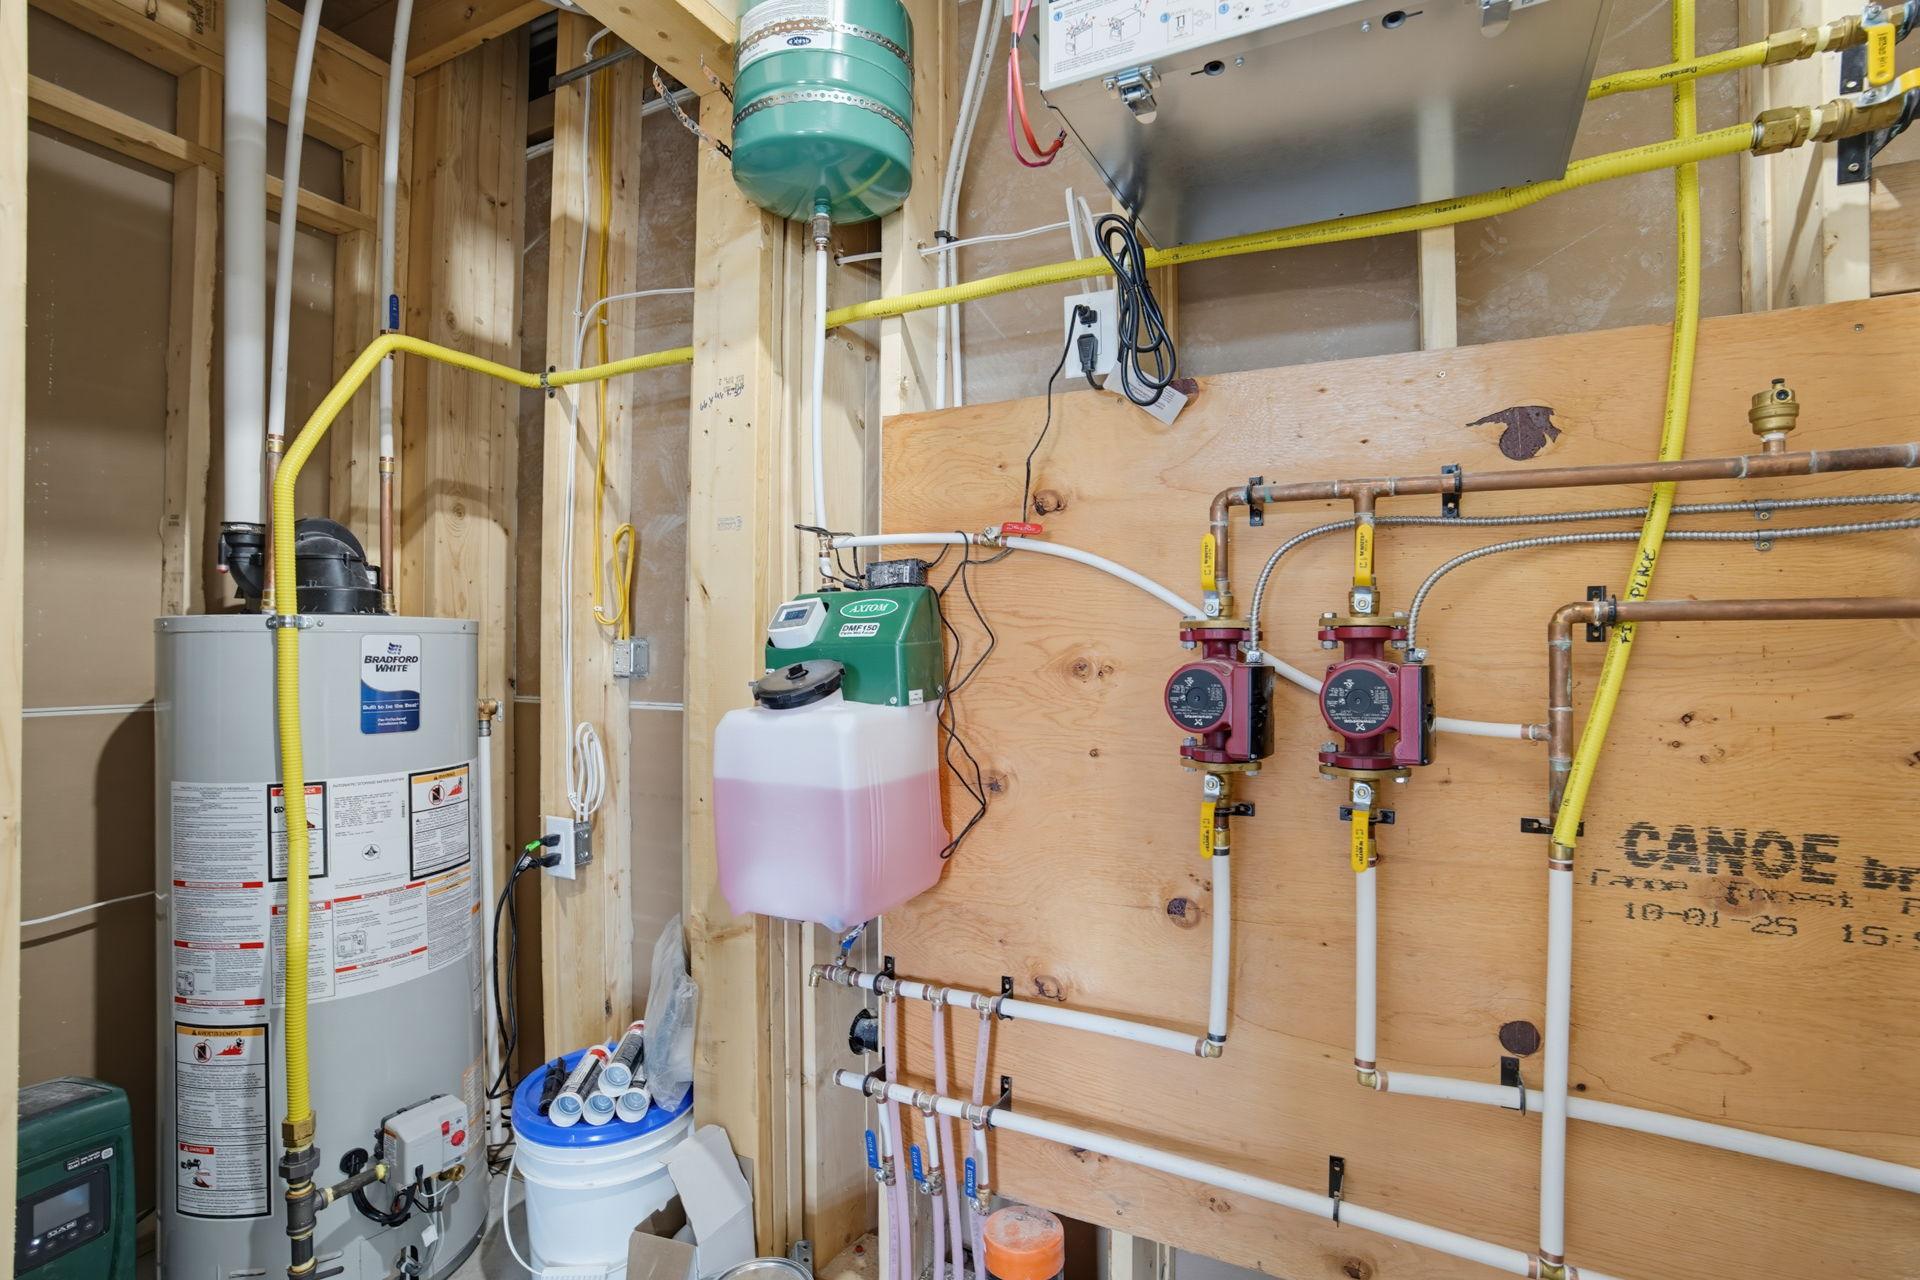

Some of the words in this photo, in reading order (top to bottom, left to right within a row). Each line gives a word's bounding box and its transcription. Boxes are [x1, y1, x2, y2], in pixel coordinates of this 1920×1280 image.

[848, 603, 888, 613] AXIOM
[842, 624, 878, 632] DMF150
[364, 655, 419, 664] BRADFORD
[375, 664, 408, 673] WHITE
[1622, 821, 1840, 884] CANOE
